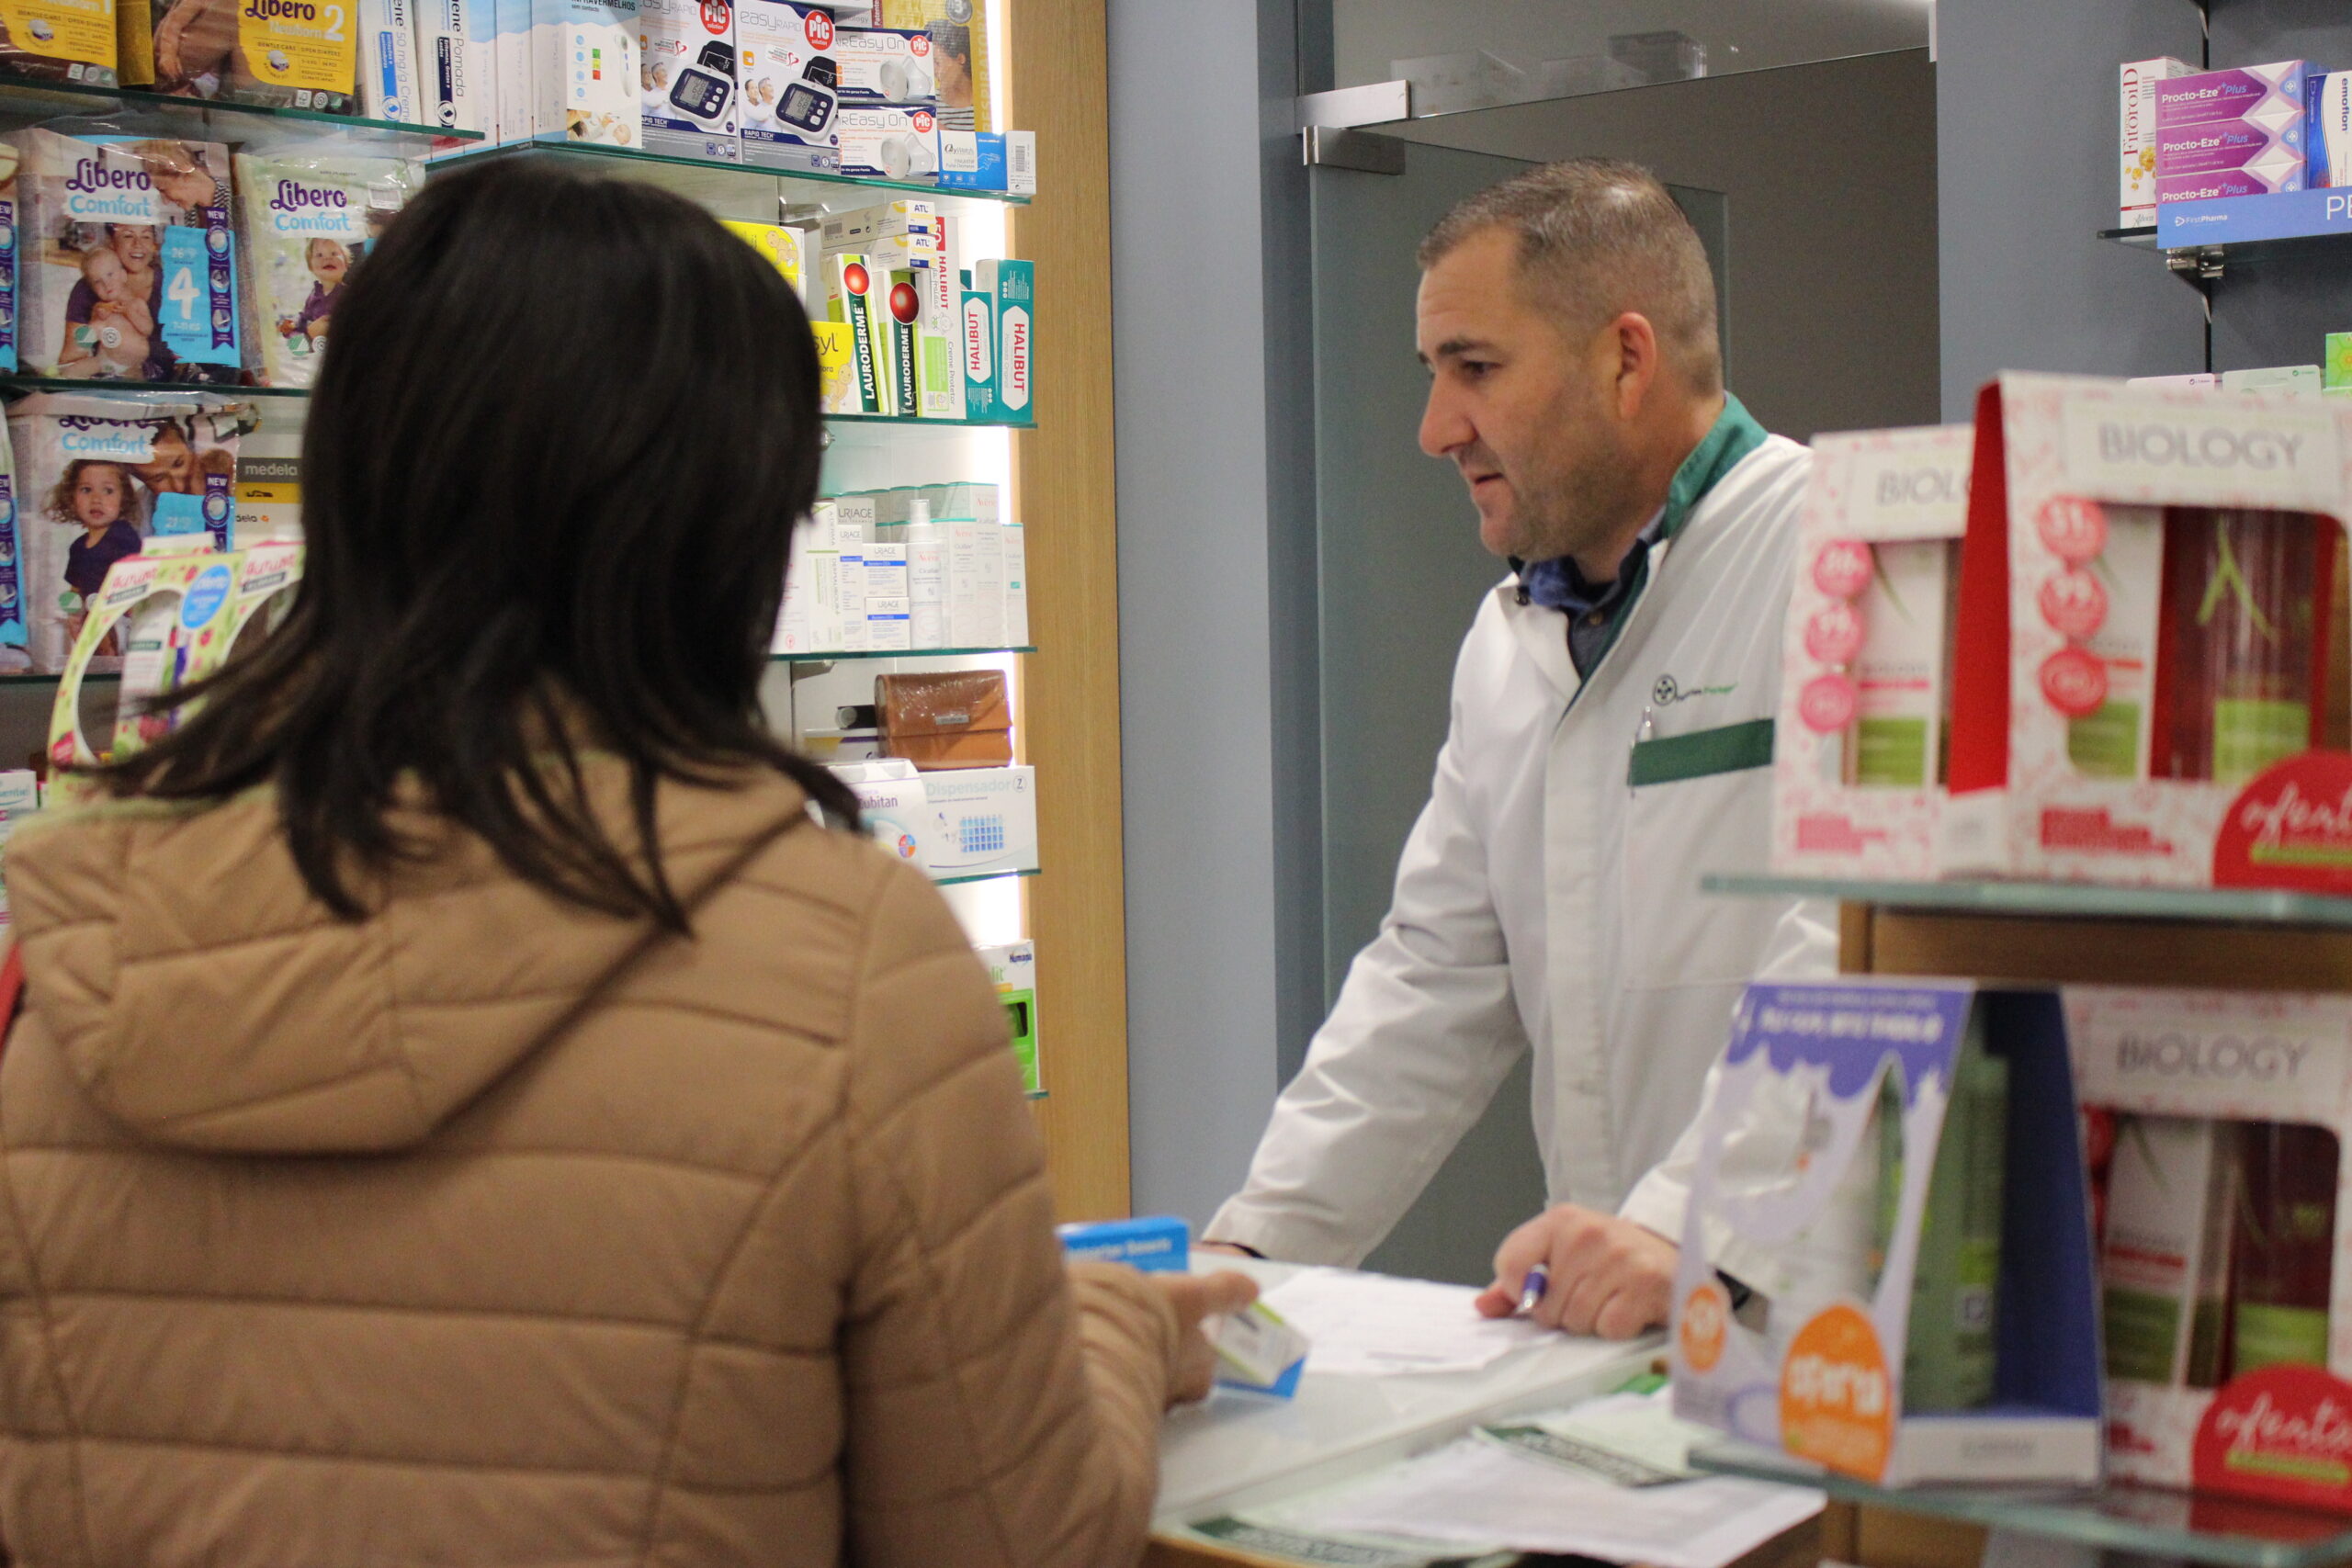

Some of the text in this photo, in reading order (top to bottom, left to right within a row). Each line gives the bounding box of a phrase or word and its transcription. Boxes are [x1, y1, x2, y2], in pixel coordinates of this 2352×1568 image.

[243, 0, 315, 20] Libero
[323, 5, 345, 42] 2
[396, 31, 407, 47] 50
[887, 37, 905, 50] On
[454, 38, 466, 97] Pomada
[2162, 88, 2220, 103] Procto-Eze
[888, 114, 908, 126] On
[2163, 138, 2221, 152] Procto-Eze
[66, 158, 152, 194] Libero
[70, 195, 152, 217] Comfort
[270, 179, 347, 212] Libero
[2162, 188, 2220, 201] Procto-Eze
[207, 210, 226, 220] NEW
[276, 212, 352, 231] Comfort
[168, 266, 200, 320] 4
[939, 256, 949, 310] HALIBUT
[968, 312, 980, 370] HALIBUT
[854, 306, 876, 400] LAURODERME
[1014, 323, 1025, 391] HALIBUT
[900, 325, 913, 406] LAURODERME
[62, 433, 148, 457] Comfort
[2099, 422, 2303, 469] BIOLOGY
[244, 463, 299, 476] medela
[207, 477, 227, 487] NEW
[1877, 467, 1975, 504] BIOL
[838, 508, 873, 520] URIAGE
[926, 779, 1011, 797] Dispensador
[2117, 1031, 2307, 1079] BIOLOGY
